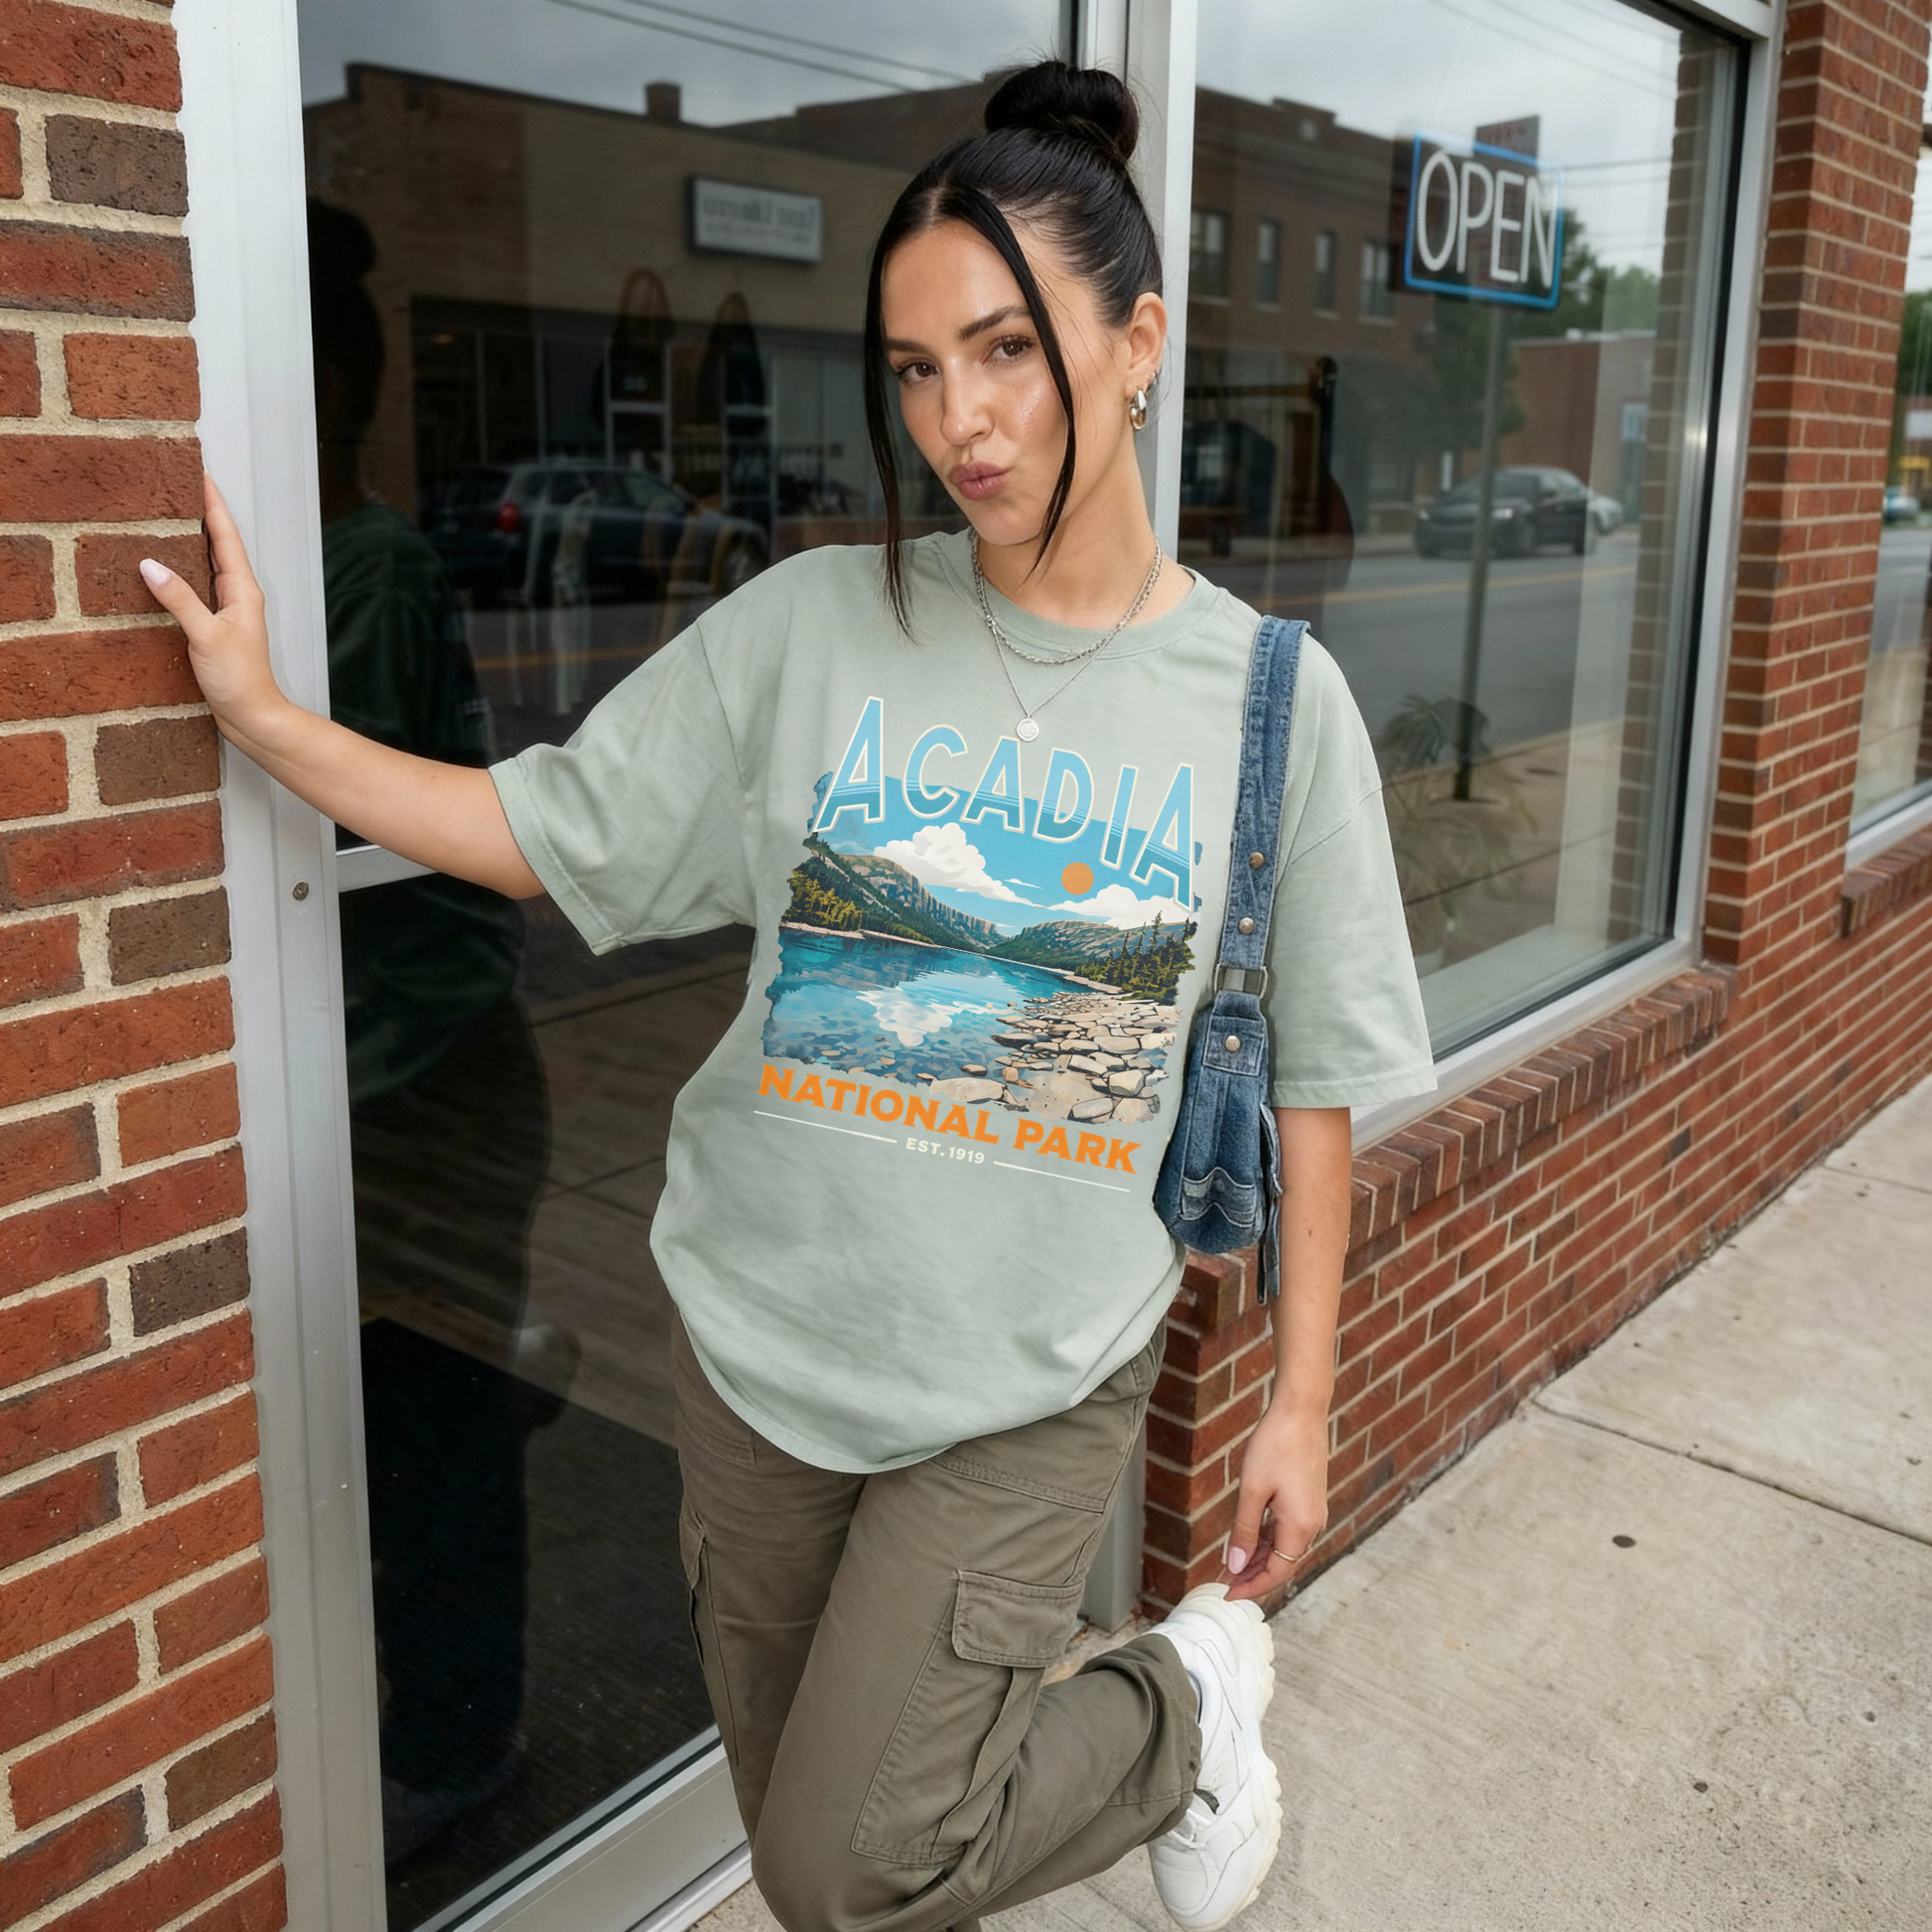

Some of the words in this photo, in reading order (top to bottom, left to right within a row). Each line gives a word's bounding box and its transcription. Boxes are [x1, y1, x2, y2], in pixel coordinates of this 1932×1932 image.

[1417, 151, 1558, 288] OPEN
[813, 696, 1193, 912] ACADIA
[757, 1064, 1000, 1145] NATIONAL
[1013, 1118, 1143, 1174] PARK
